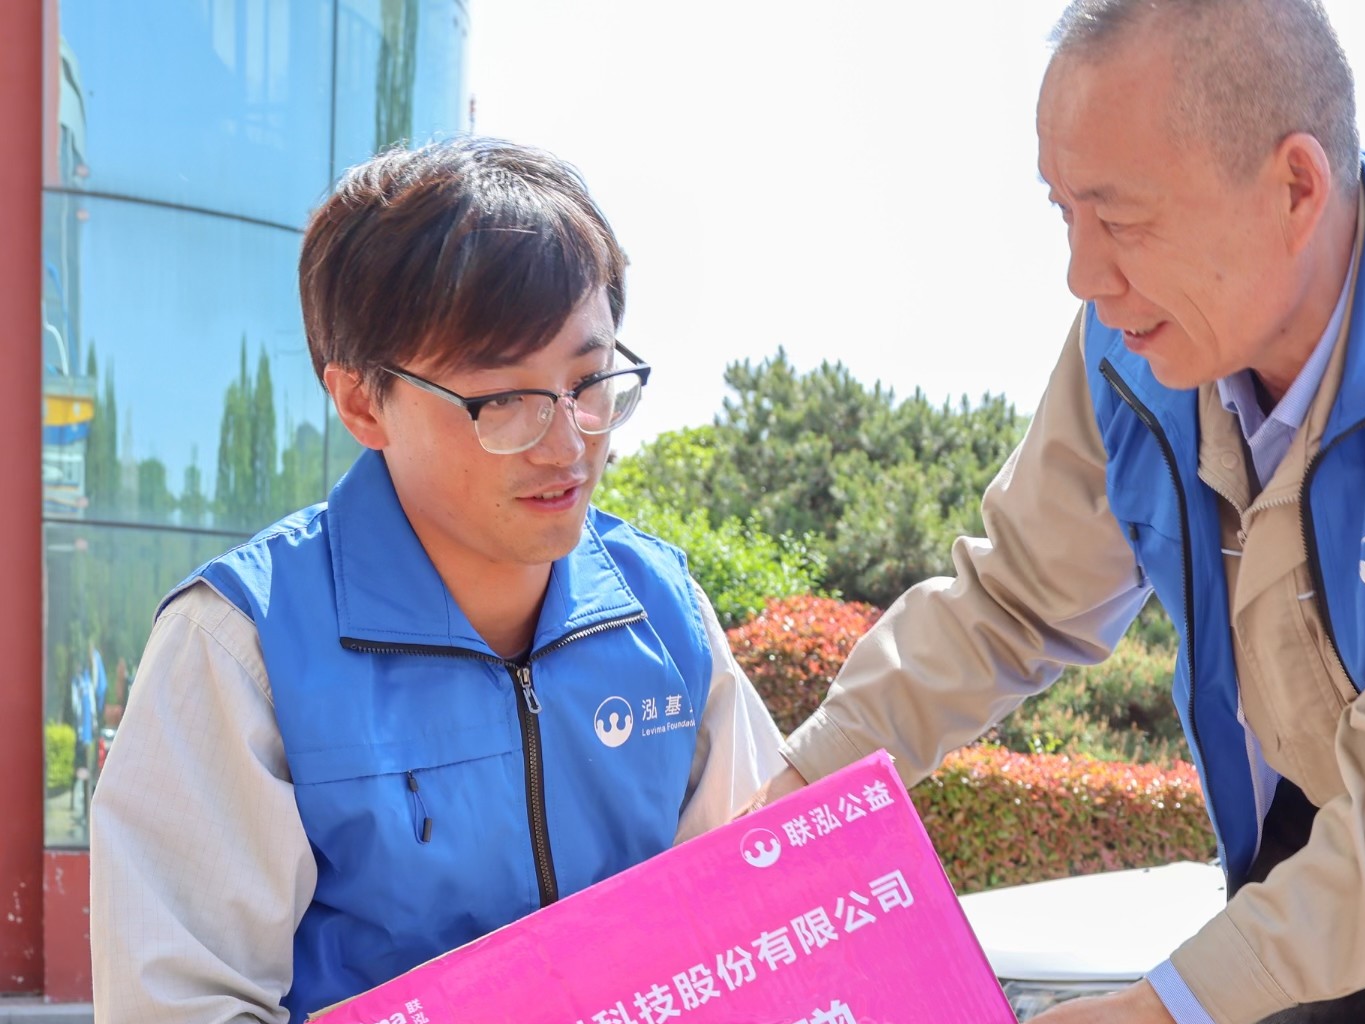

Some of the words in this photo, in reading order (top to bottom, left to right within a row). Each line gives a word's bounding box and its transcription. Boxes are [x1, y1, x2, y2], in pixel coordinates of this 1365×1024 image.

[642, 694, 693, 721] 泓基
[642, 724, 666, 737] Levima
[782, 779, 895, 848] 联泓公益
